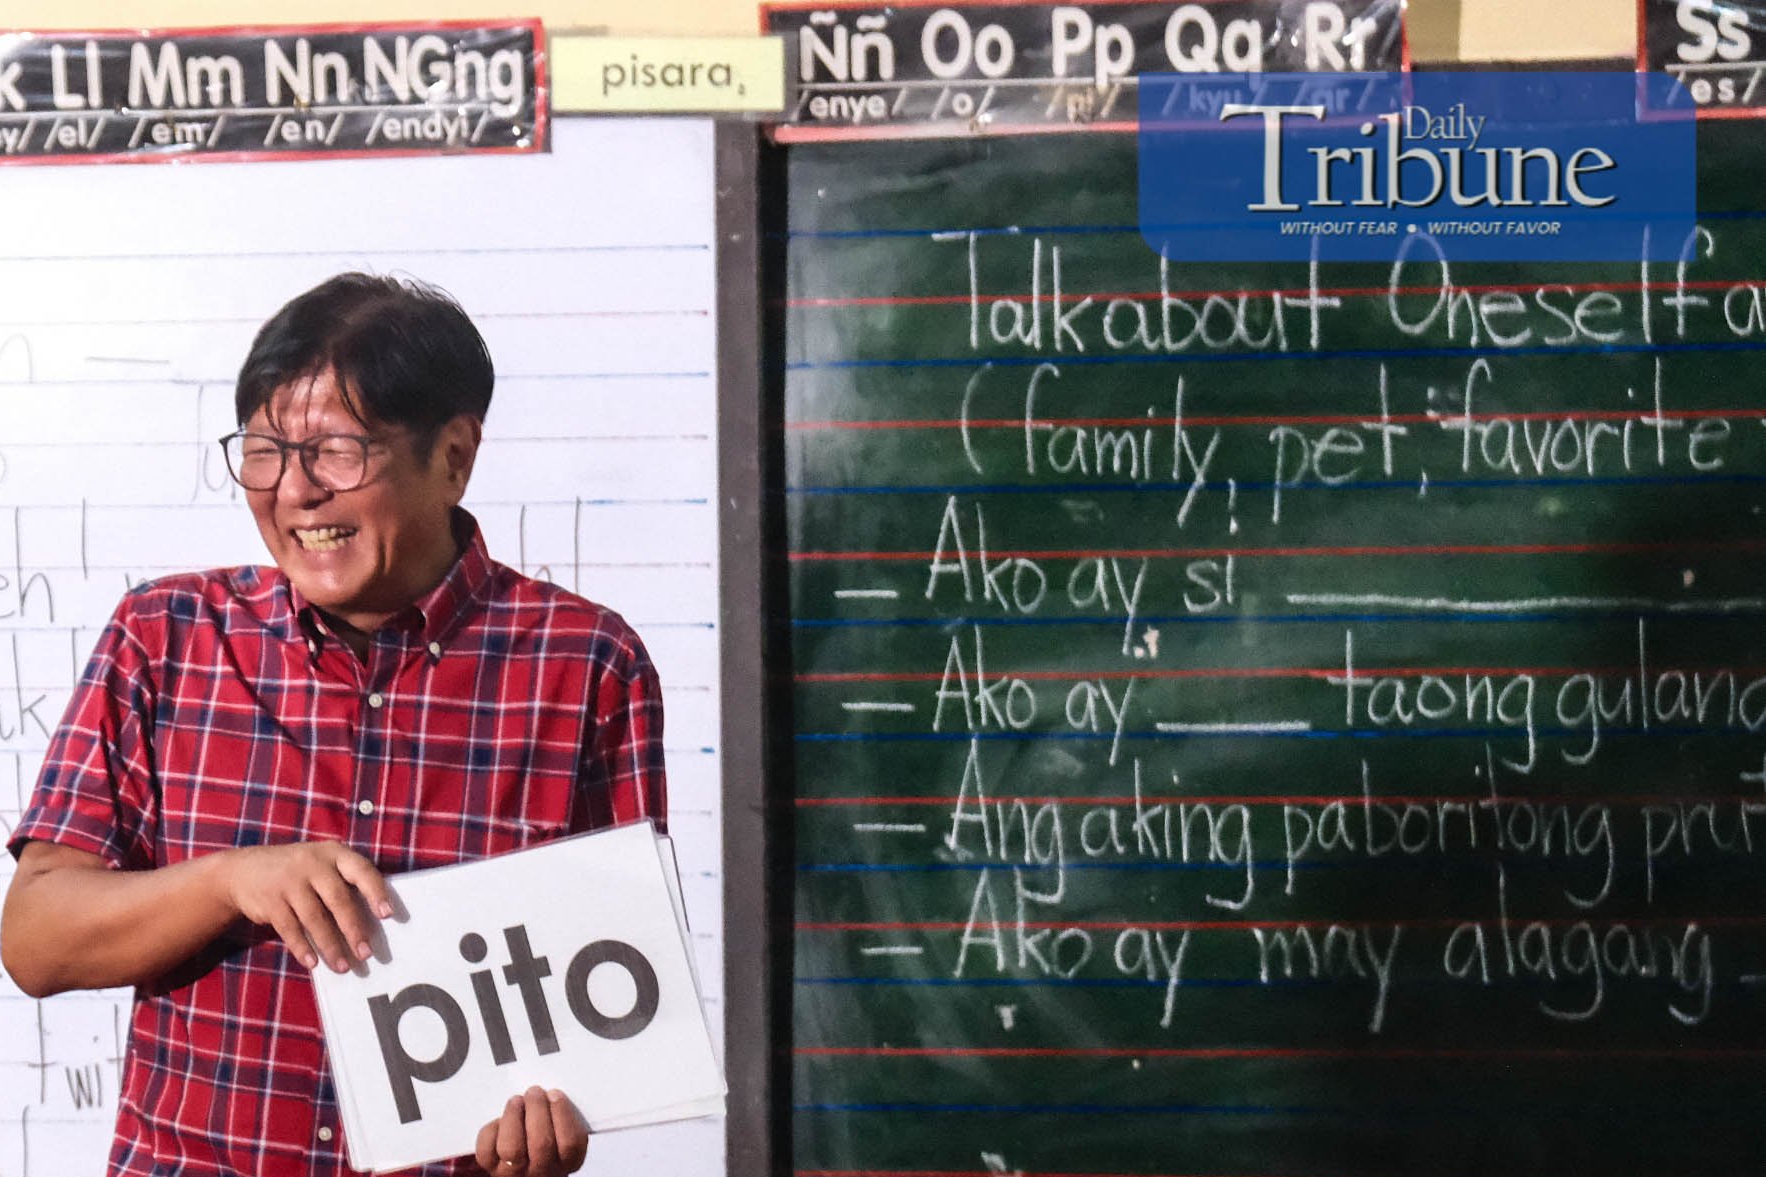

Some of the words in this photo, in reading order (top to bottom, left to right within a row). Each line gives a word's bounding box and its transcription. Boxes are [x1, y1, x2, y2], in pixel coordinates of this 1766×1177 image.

[51, 40, 102, 109] Ll
[128, 41, 246, 107] Mm
[263, 37, 350, 105] Nn
[364, 35, 524, 117] NGng
[799, 11, 894, 82] Ññ
[921, 8, 1015, 78] Oo
[1051, 6, 1135, 94] Pp
[1164, 4, 1263, 92] Qq
[1305, 2, 1379, 71] Rr
[1676, 0, 1751, 62] Ss
[1388, 226, 1715, 347] Oneself
[925, 494, 1047, 605] Ako
[1066, 552, 1148, 656] ay
[934, 625, 1036, 733] Ako
[1066, 671, 1136, 766] ay
[1327, 629, 1535, 771] taong
[945, 737, 1067, 903] Ang
[1081, 758, 1255, 909] aking
[954, 866, 1091, 979] Ako
[1113, 928, 1191, 1028] ay
[1253, 922, 1403, 1034] may
[366, 924, 660, 1125] pito
